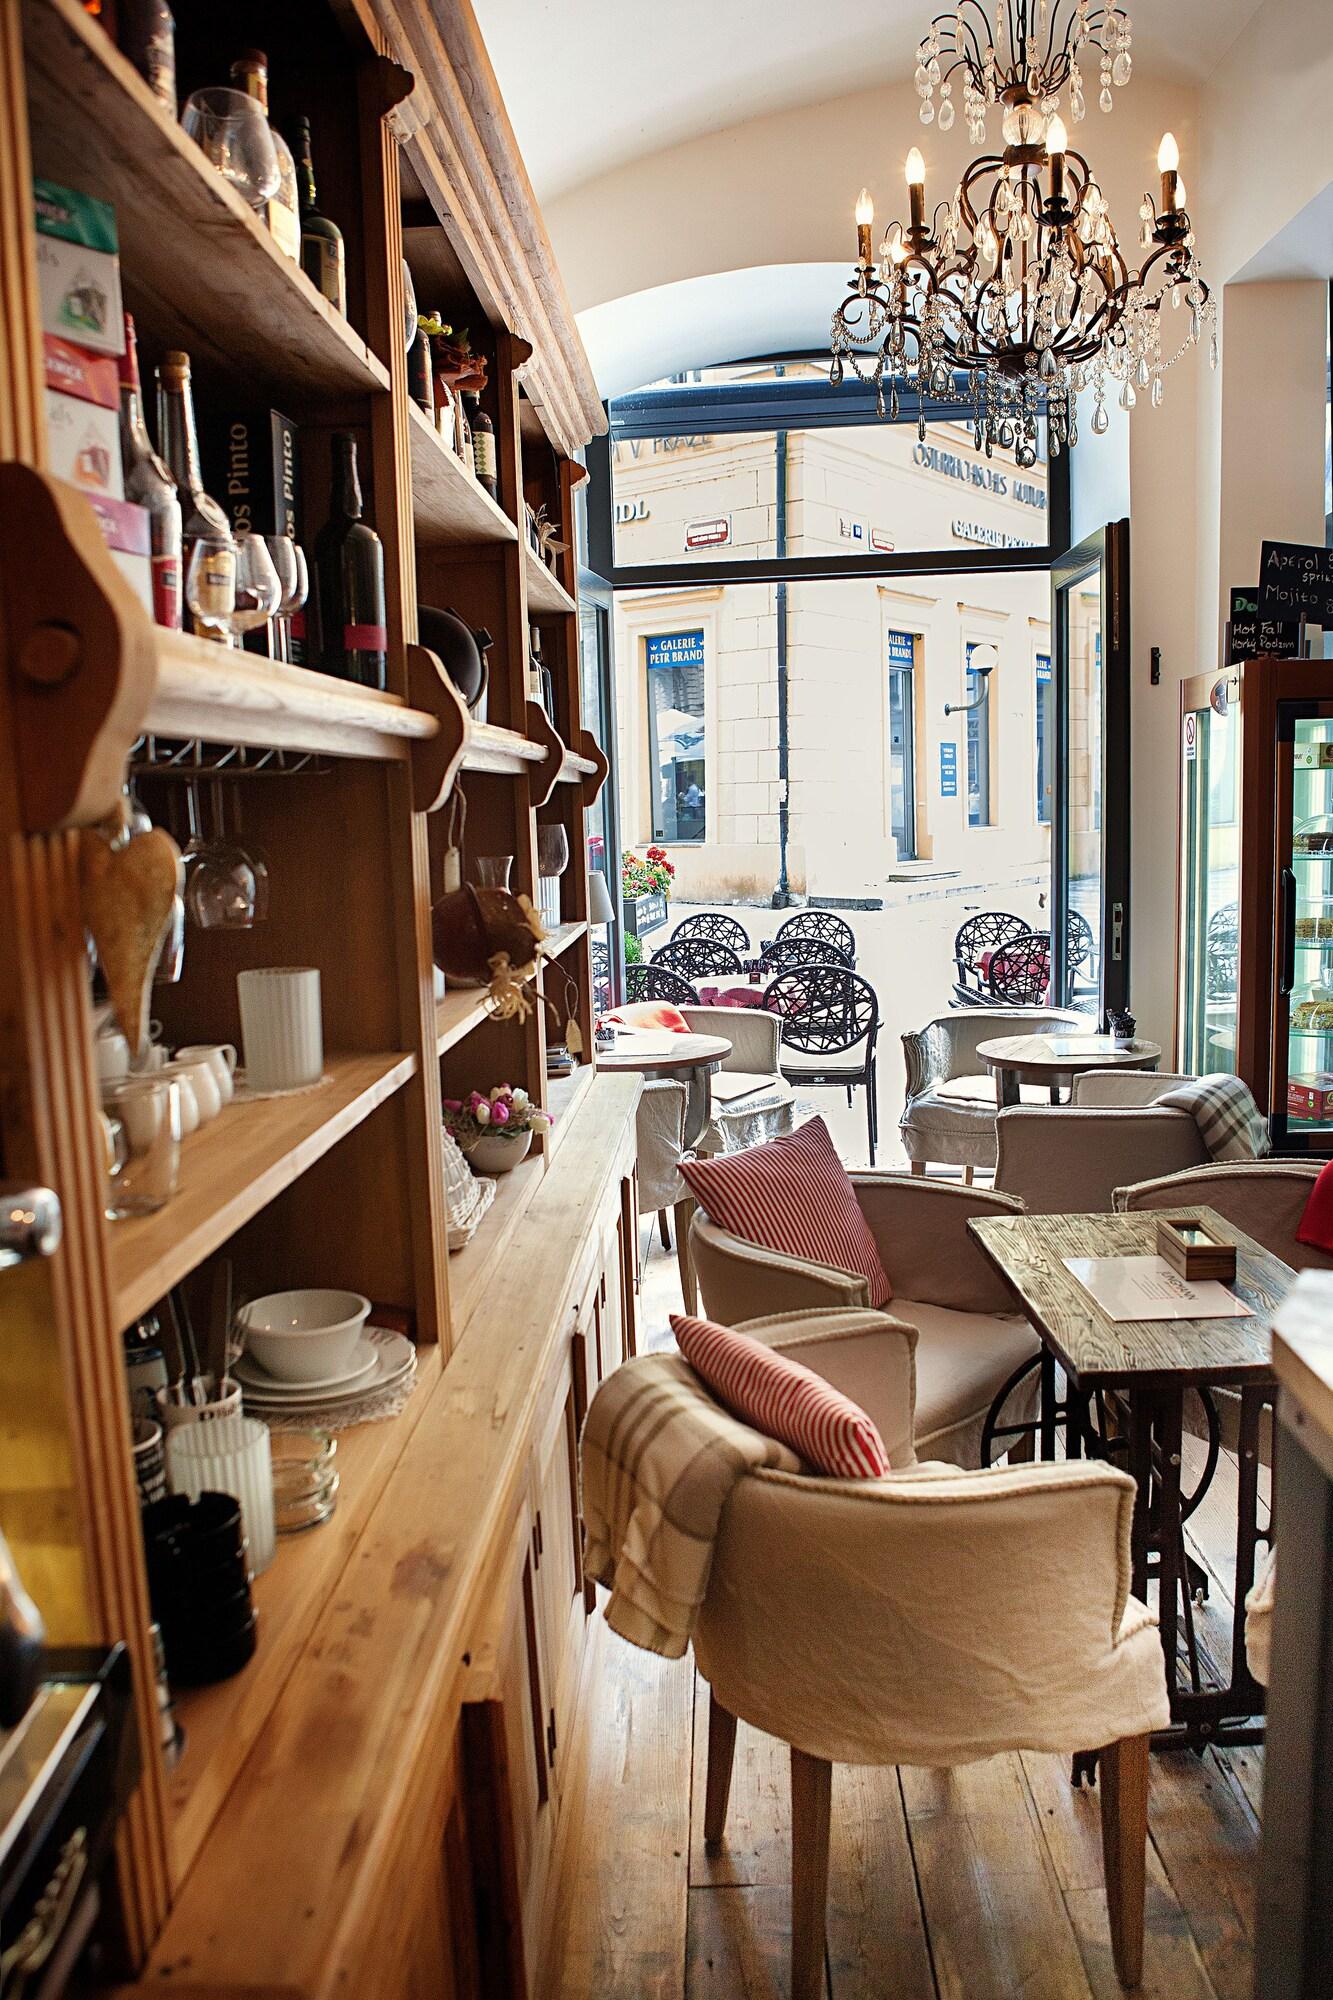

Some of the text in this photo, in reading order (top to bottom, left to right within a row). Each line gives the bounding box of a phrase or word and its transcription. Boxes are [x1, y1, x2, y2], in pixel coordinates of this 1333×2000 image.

[227, 423, 249, 495] Pinto
[282, 429, 294, 501] Pinto
[1265, 584, 1319, 606] Mojito
[1233, 621, 1283, 635] Hot Fall
[660, 637, 696, 651] GALERIE
[650, 652, 670, 664] PETR
